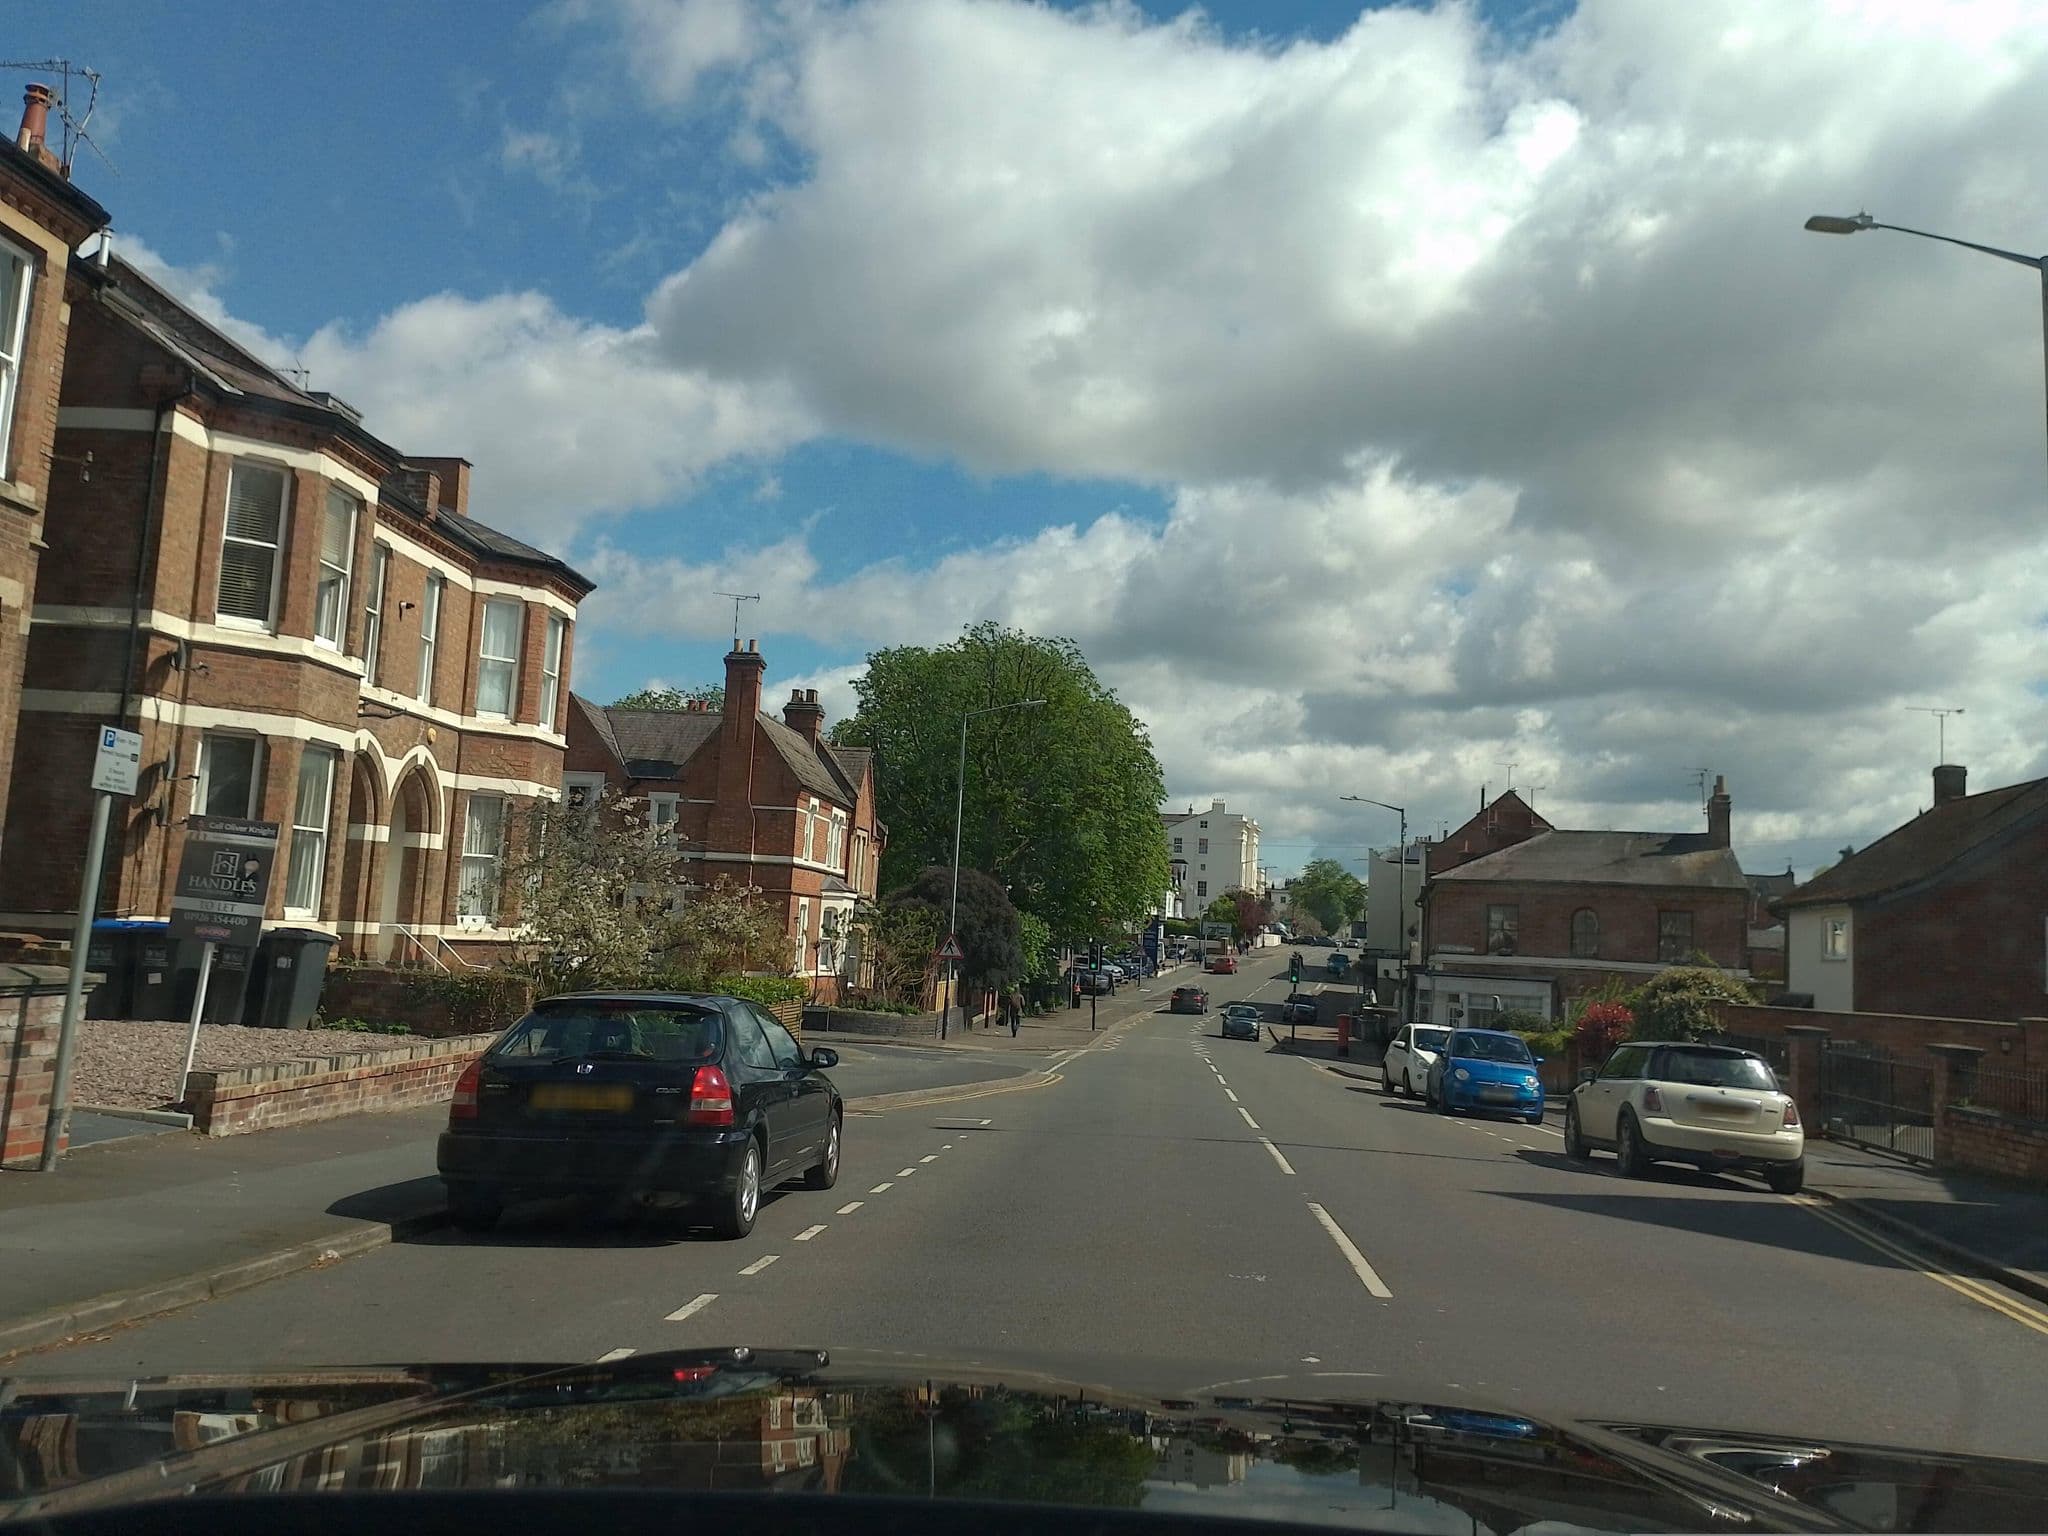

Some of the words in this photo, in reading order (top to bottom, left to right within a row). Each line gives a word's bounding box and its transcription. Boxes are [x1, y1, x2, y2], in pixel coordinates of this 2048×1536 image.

[224, 823, 248, 833] Oliver
[248, 826, 276, 837] Knight
[188, 874, 257, 893] HANDLES
[200, 901, 214, 910] TO
[217, 902, 238, 913] LET
[211, 914, 249, 926] 354400
